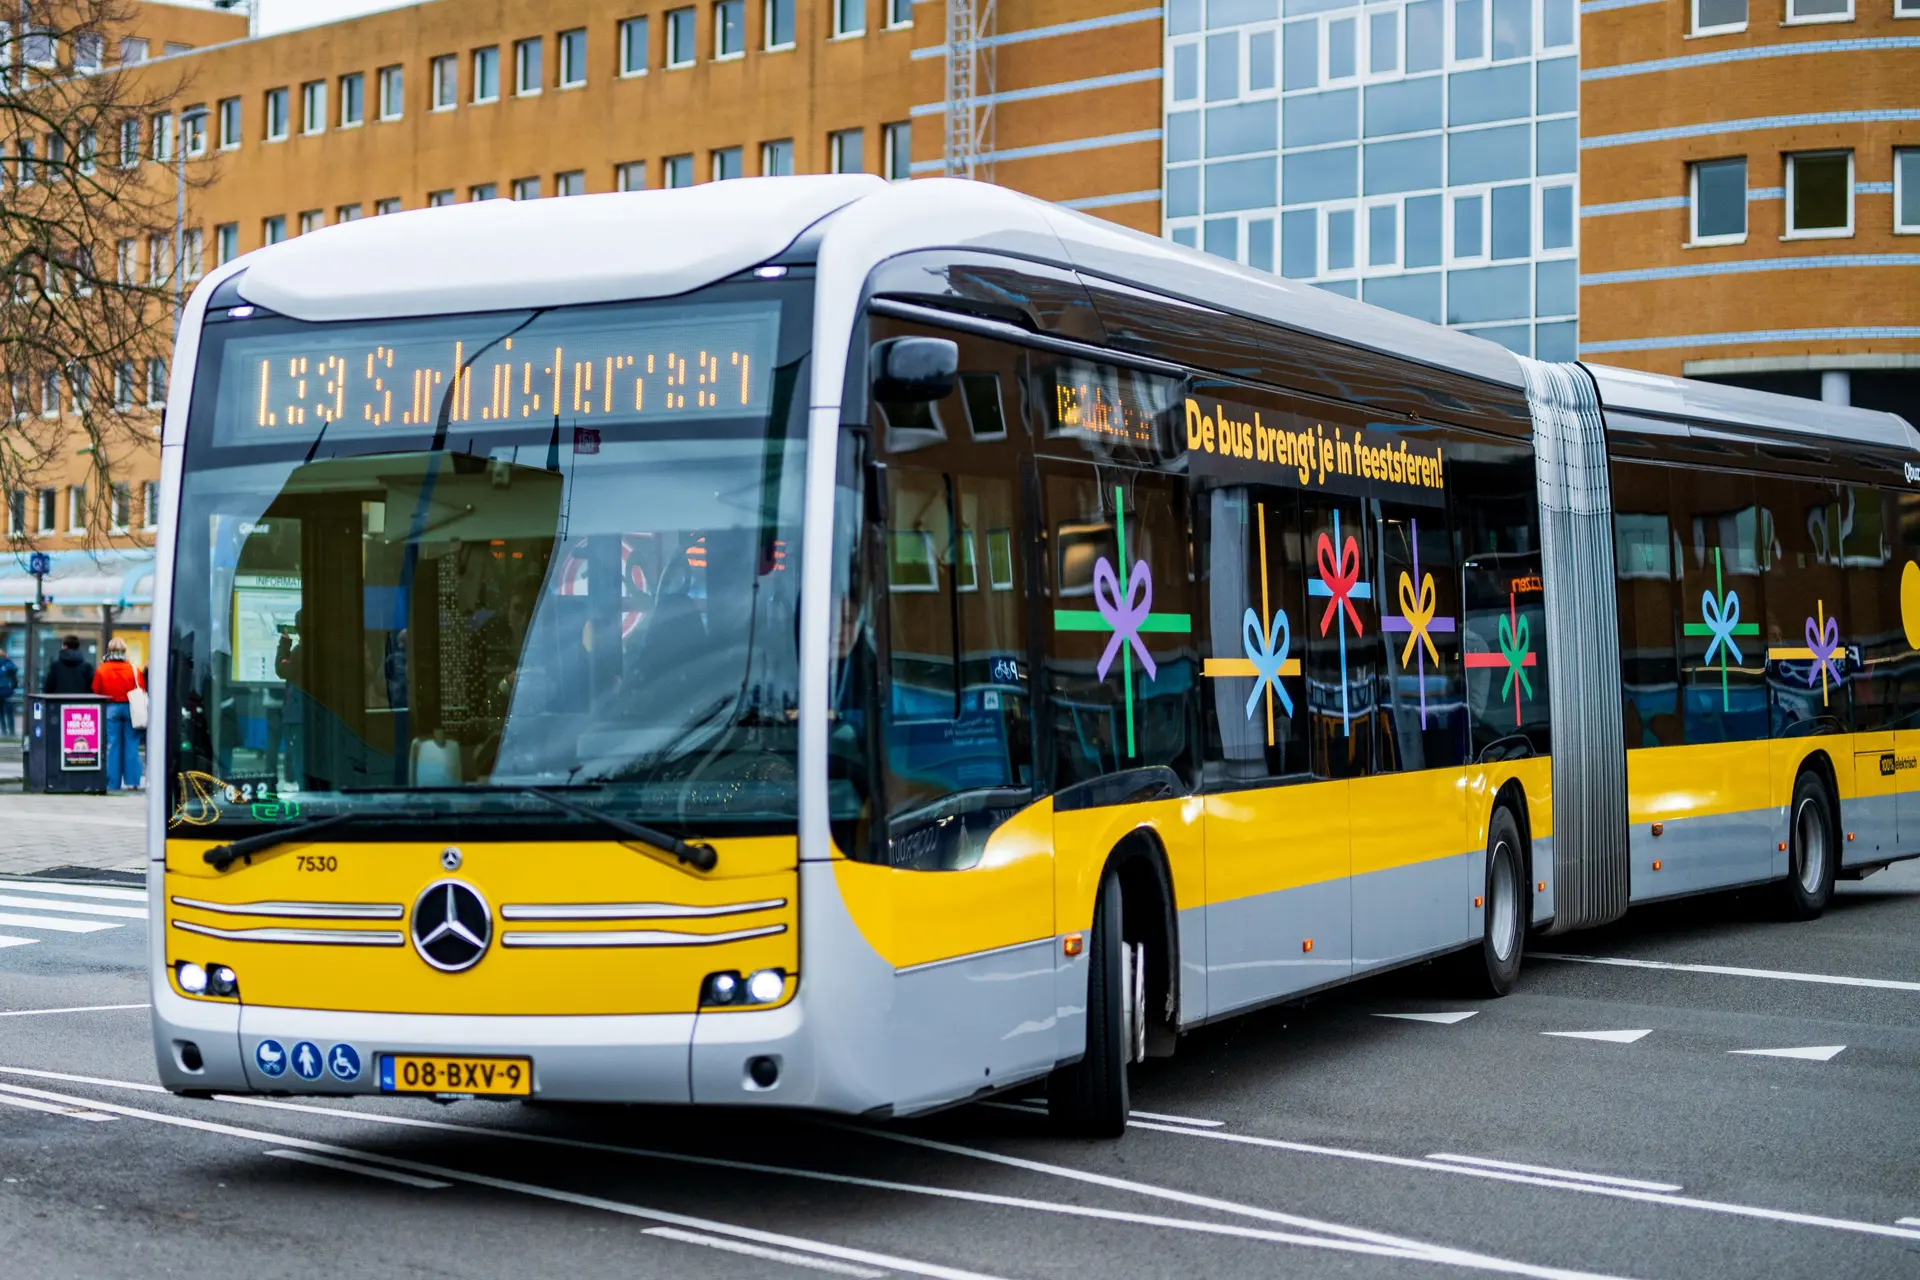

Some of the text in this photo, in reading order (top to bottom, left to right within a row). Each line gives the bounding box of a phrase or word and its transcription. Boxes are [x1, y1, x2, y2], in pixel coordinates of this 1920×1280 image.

[1185, 398, 1215, 453] De
[1217, 404, 1253, 460] bus
[1254, 411, 1317, 485] brengt
[1317, 423, 1335, 485] je
[1335, 427, 1353, 475] in
[1354, 431, 1444, 489] feestsferen!
[254, 575, 301, 588] INFORMAT
[296, 856, 338, 872] 7530
[403, 1061, 521, 1089] 08-BXV-9
